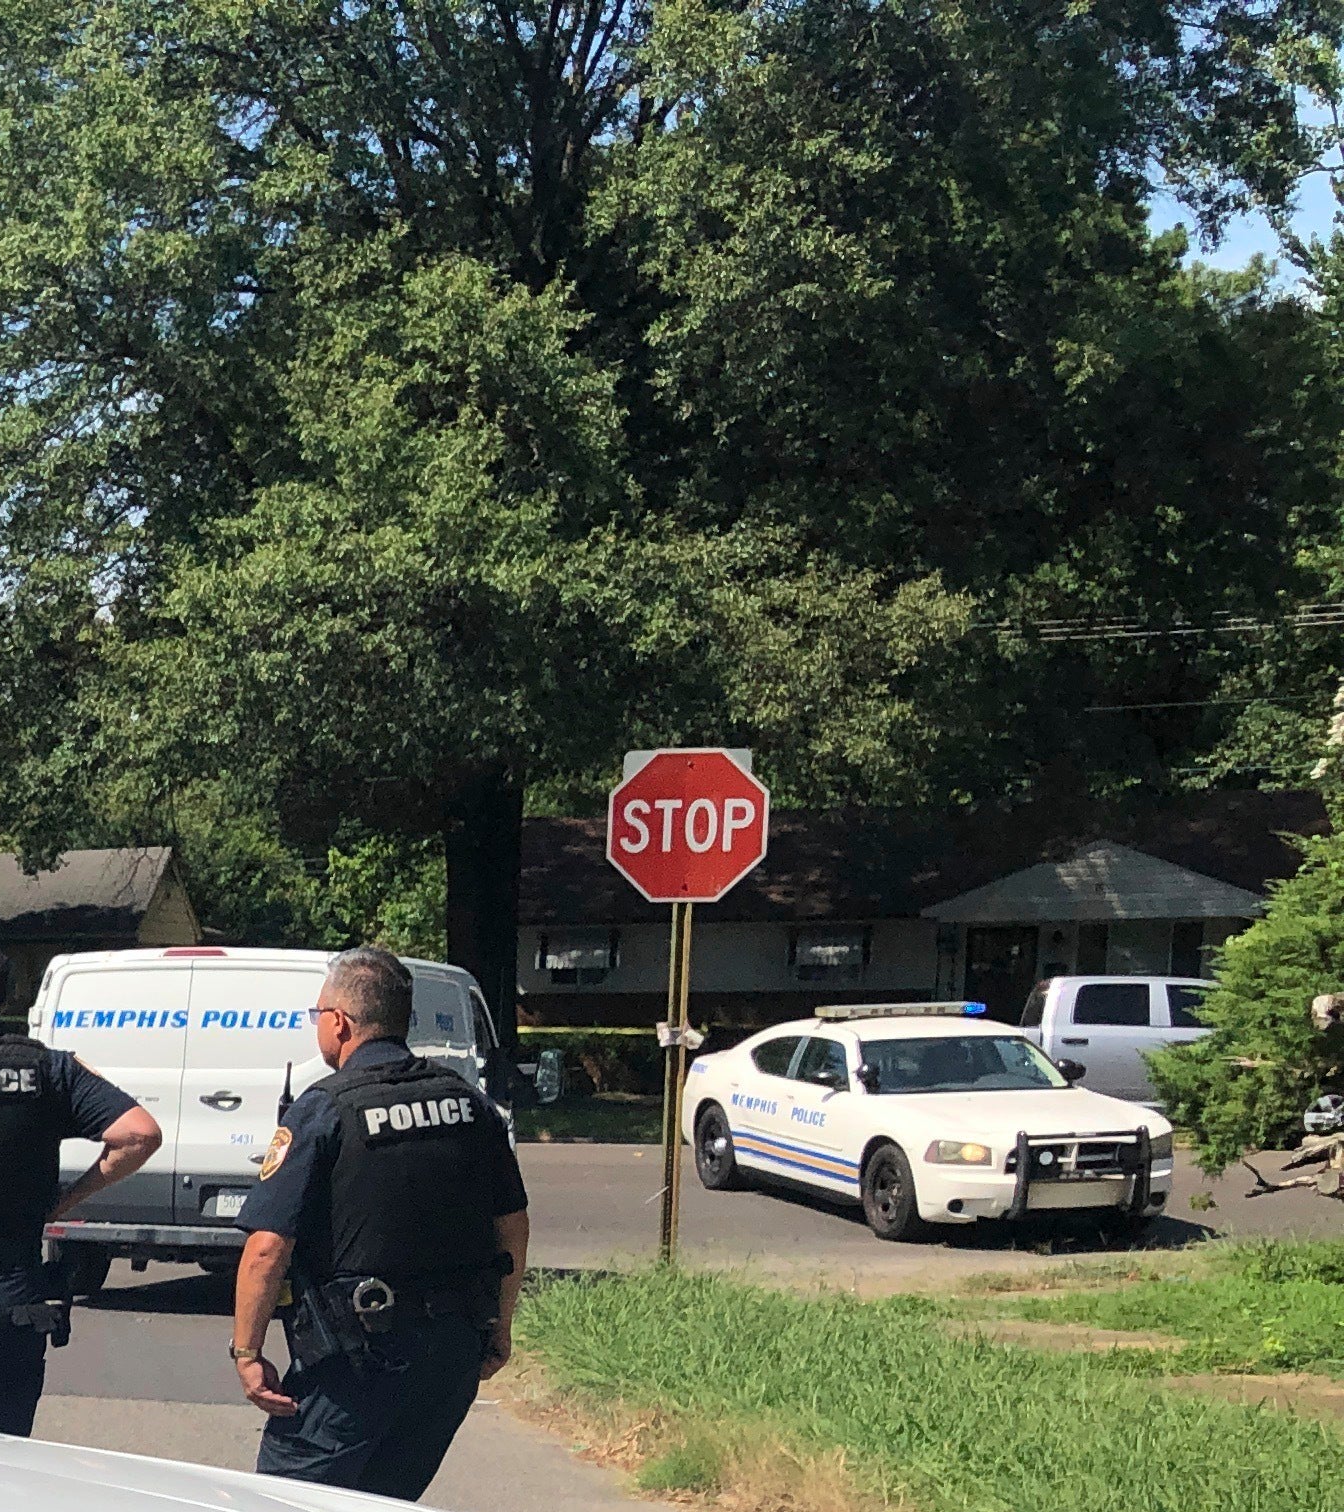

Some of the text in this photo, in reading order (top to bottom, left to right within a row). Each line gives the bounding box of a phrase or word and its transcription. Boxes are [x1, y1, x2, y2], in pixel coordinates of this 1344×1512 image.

[620, 798, 755, 854] STOP
[53, 1010, 305, 1030] MEMPHIS POLICE
[364, 1098, 474, 1136] POLICE
[731, 1093, 827, 1127] MEMPHIS POLICE
[230, 1133, 254, 1144] 5431
